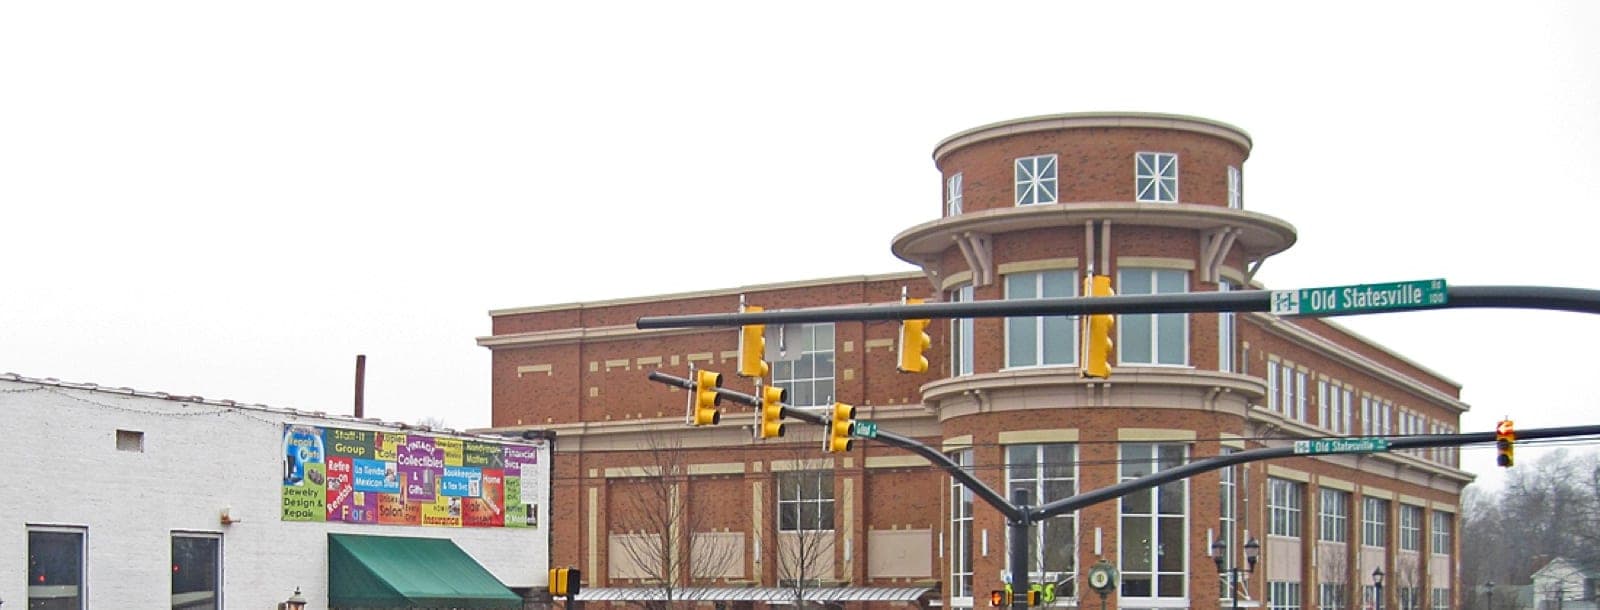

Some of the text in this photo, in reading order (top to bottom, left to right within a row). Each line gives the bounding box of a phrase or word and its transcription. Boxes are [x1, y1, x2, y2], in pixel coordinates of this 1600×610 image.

[1311, 289, 1336, 311] Old
[1342, 284, 1422, 309] Statesville
[335, 443, 366, 456] Group
[1315, 441, 1329, 452] Old
[1332, 440, 1374, 452] Statesville
[398, 453, 443, 469] Collectibles
[355, 477, 383, 487] Mexican
[284, 487, 319, 499] Jewelry
[283, 498, 324, 509] Design &
[379, 504, 402, 517] Salon
